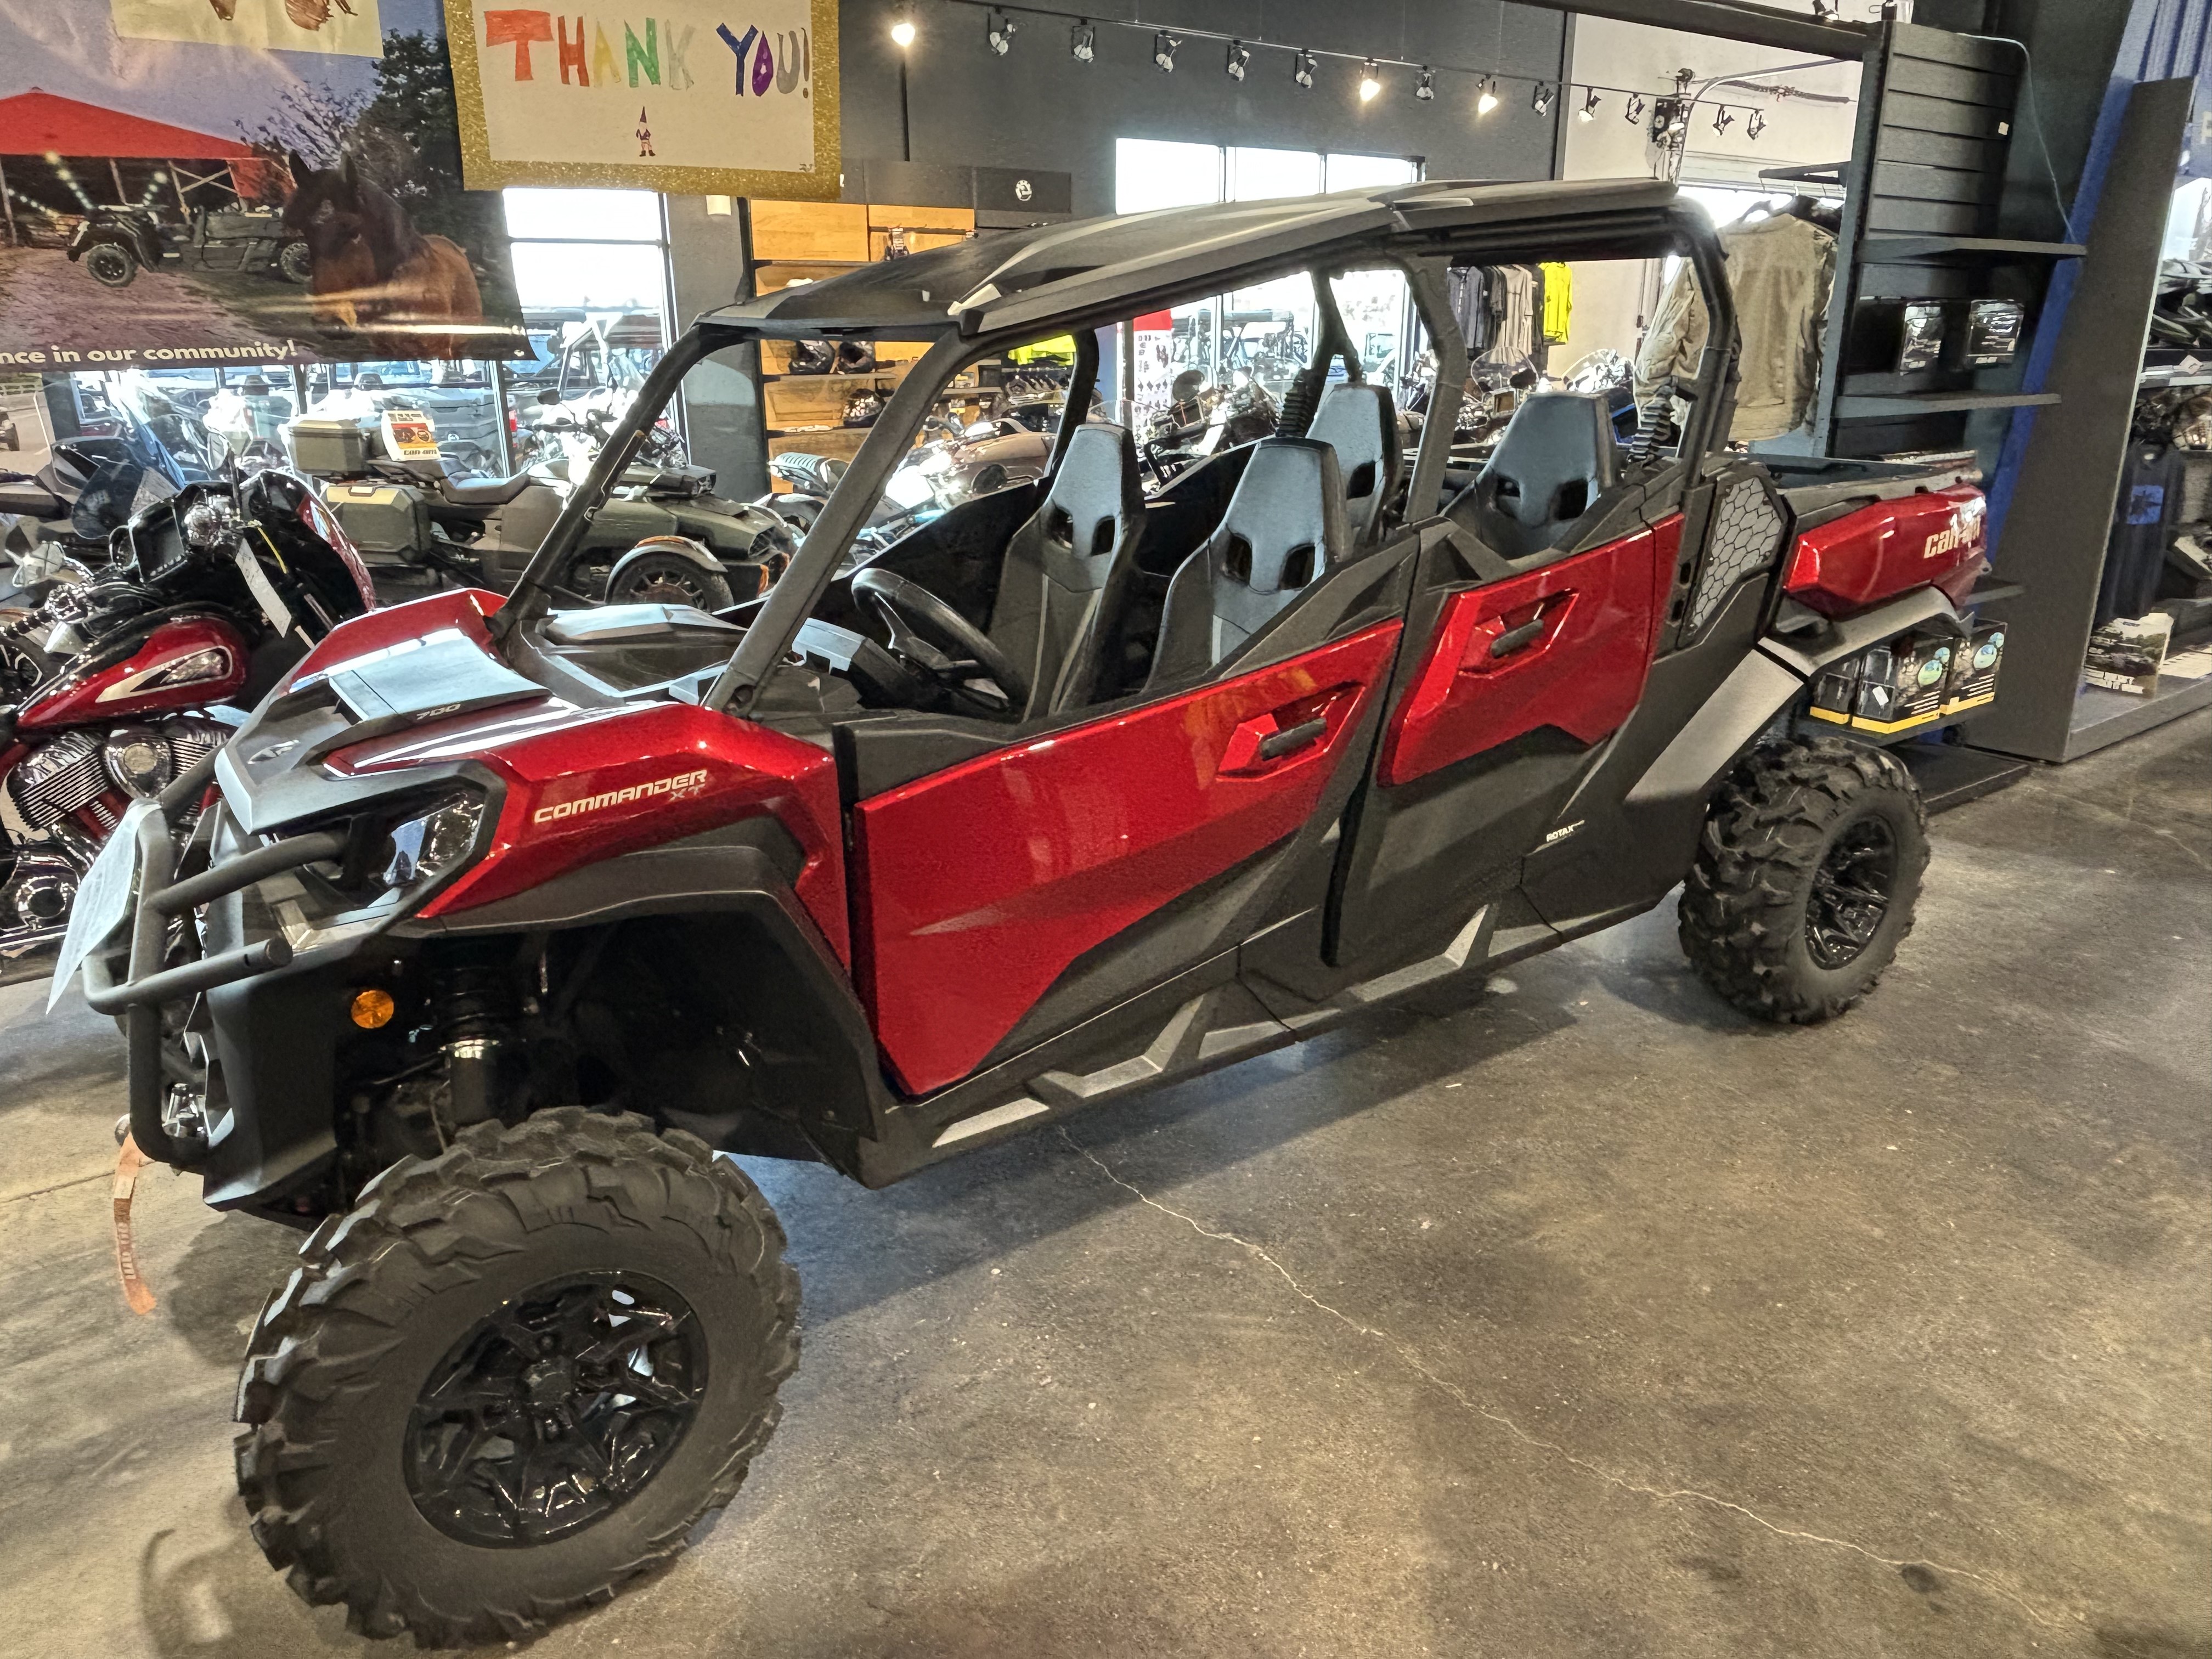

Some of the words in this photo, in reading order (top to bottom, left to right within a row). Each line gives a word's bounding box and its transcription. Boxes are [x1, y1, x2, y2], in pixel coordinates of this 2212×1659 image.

[484, 9, 696, 91] THANK
[715, 22, 810, 99] YOU!
[50, 345, 81, 363] in
[87, 349, 137, 362] our
[143, 339, 299, 360] community!
[416, 703, 461, 720] 700
[533, 769, 708, 823] COMMANDER
[668, 783, 706, 802] XT
[1545, 820, 1585, 843] ROTAX
